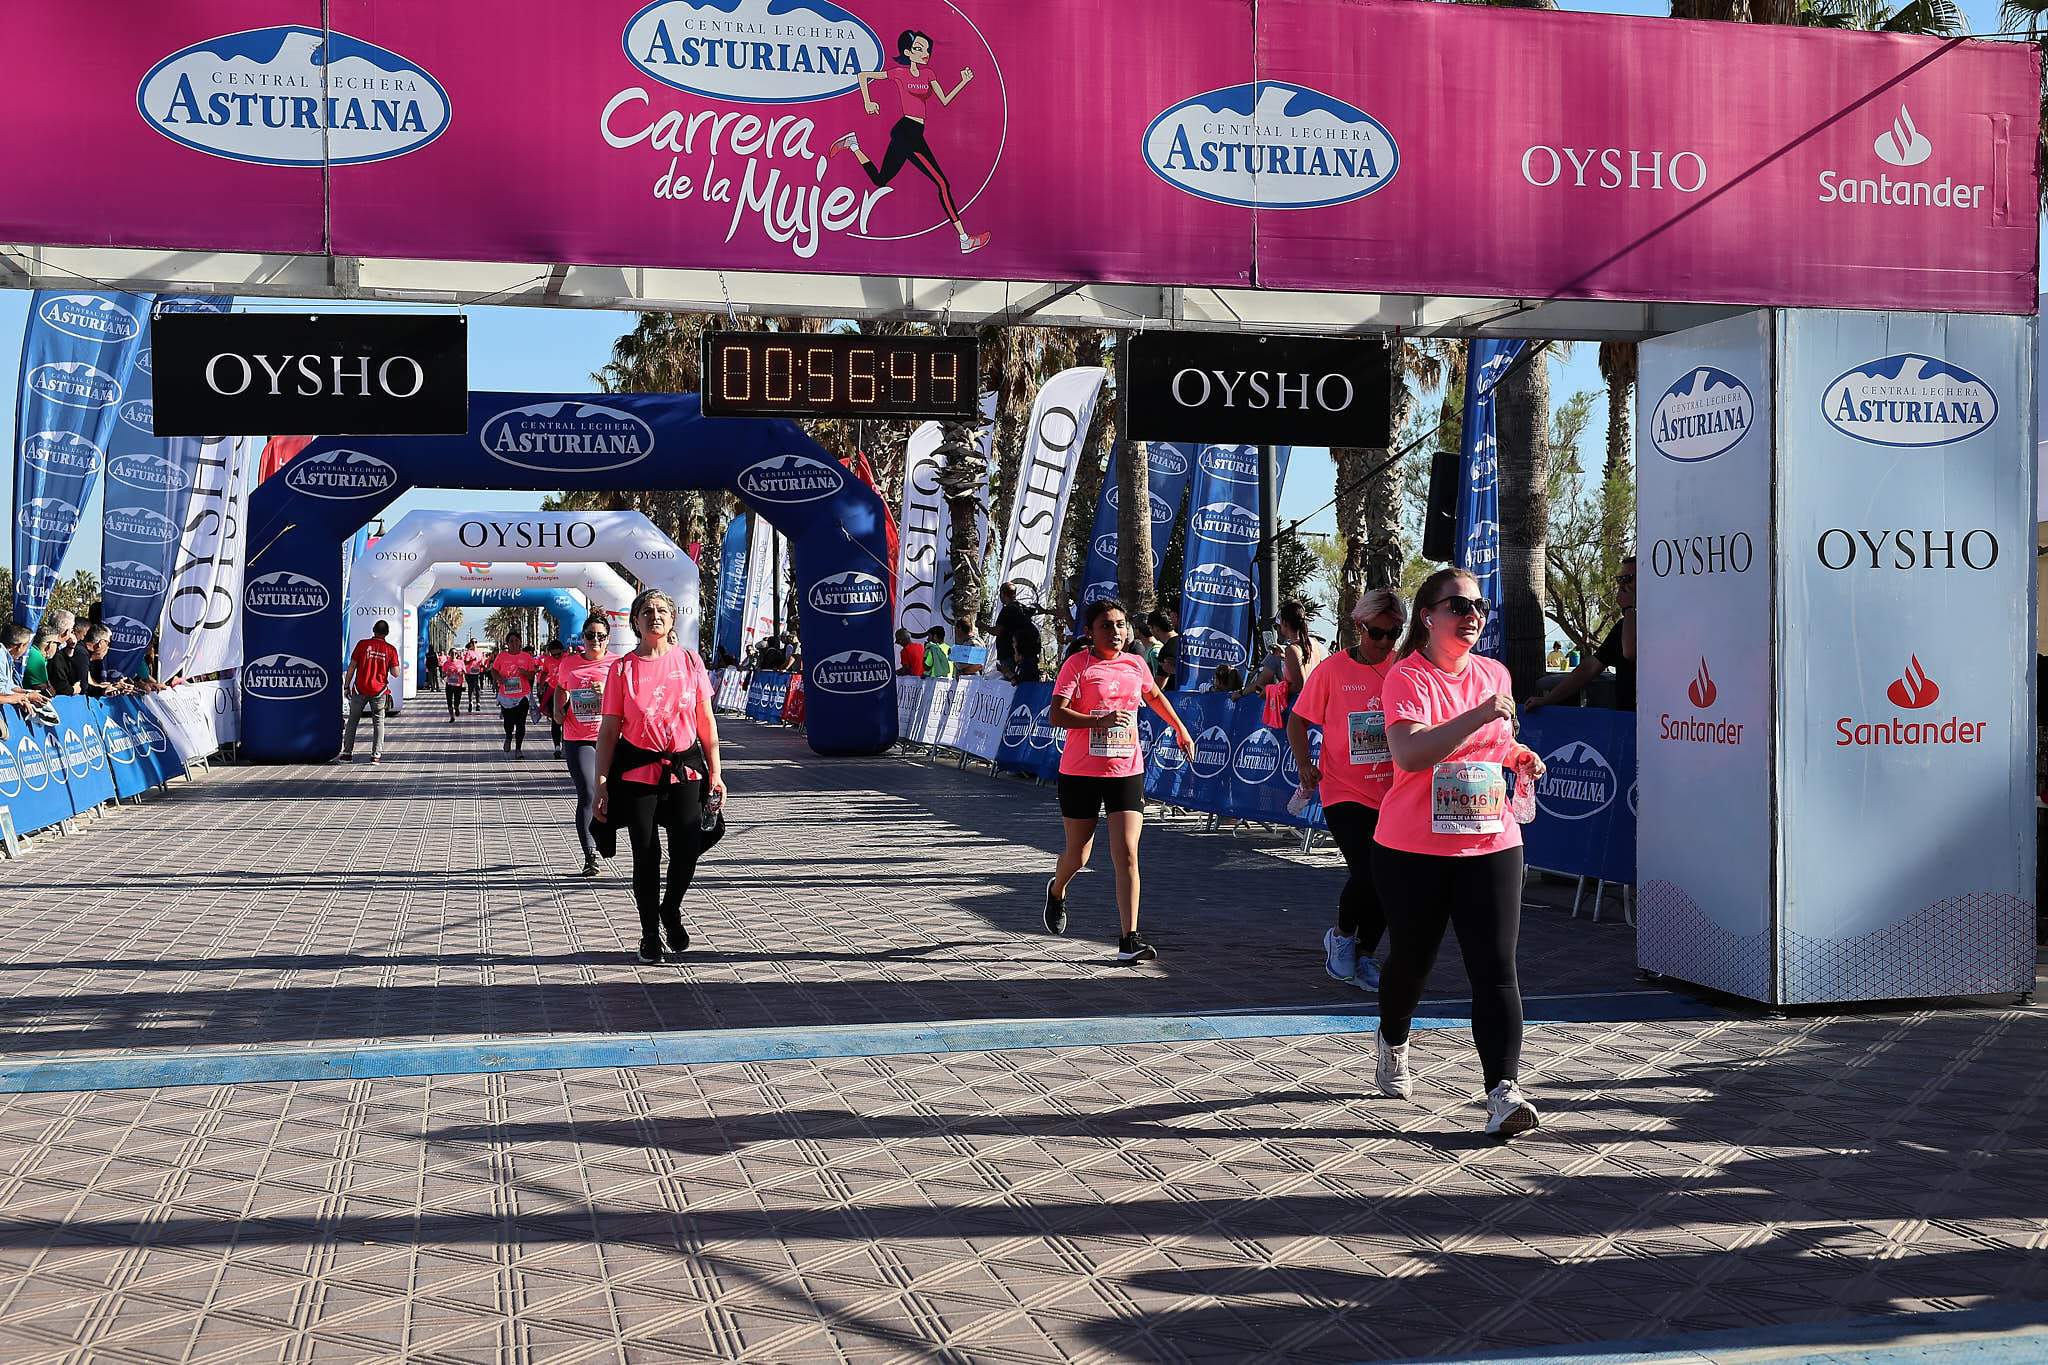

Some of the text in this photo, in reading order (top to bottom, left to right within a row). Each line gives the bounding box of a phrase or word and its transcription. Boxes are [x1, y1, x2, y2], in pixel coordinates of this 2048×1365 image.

[684, 18, 856, 41] CENTRAL LECHERA
[643, 19, 862, 76] ASTURIANA
[211, 71, 309, 88] CENTRAL
[907, 82, 930, 91] OYSHO
[163, 72, 428, 133] ASTURIANA
[600, 87, 816, 154] Carrera
[1203, 122, 1371, 141] CENTRAL LECHERA
[1163, 123, 1380, 178] ASTURIANA
[1521, 145, 1708, 192] OYSHO
[1818, 171, 1985, 208] Santander
[653, 155, 893, 258] de la Mujer
[46, 303, 131, 336] ASTURIANA
[205, 353, 424, 397] OYSHO
[722, 345, 958, 404] 00:56:44
[1172, 368, 1354, 412] OYSHO
[1672, 393, 1742, 413] CENTRAL LECHERA
[1862, 386, 1978, 397] CENTRAL LECHERA
[1834, 387, 1985, 424] ASTURIANA
[494, 422, 642, 454] ASTURIANA
[521, 421, 636, 431] CENTRAL LECHERA
[1657, 406, 1745, 443] ASTURIANA
[292, 468, 388, 488] ASTURIANA
[310, 465, 387, 474] CENTRAL LECHERA
[747, 474, 837, 491] ASTURIANA
[169, 437, 226, 634] OYSH
[459, 521, 596, 548] OYSHO
[1196, 513, 1260, 538] ASTURIANA
[375, 552, 417, 560] OYSHO
[634, 551, 675, 560] OYSHO
[1652, 532, 1753, 577] OYSHO
[1817, 528, 1999, 571] OYSHO
[248, 589, 324, 607] ASTURIANA
[814, 588, 884, 605] ASTURIANA
[356, 606, 396, 616] OYSHO
[247, 671, 322, 689] ASTURIANA
[818, 667, 888, 684] ASTURIANA
[1660, 713, 1744, 746] Santander
[1836, 716, 1987, 746] Santander
[1236, 749, 1276, 771] ASTURIANA
[1460, 794, 1488, 806] 016
[1537, 773, 1605, 803] ASTURIANA
